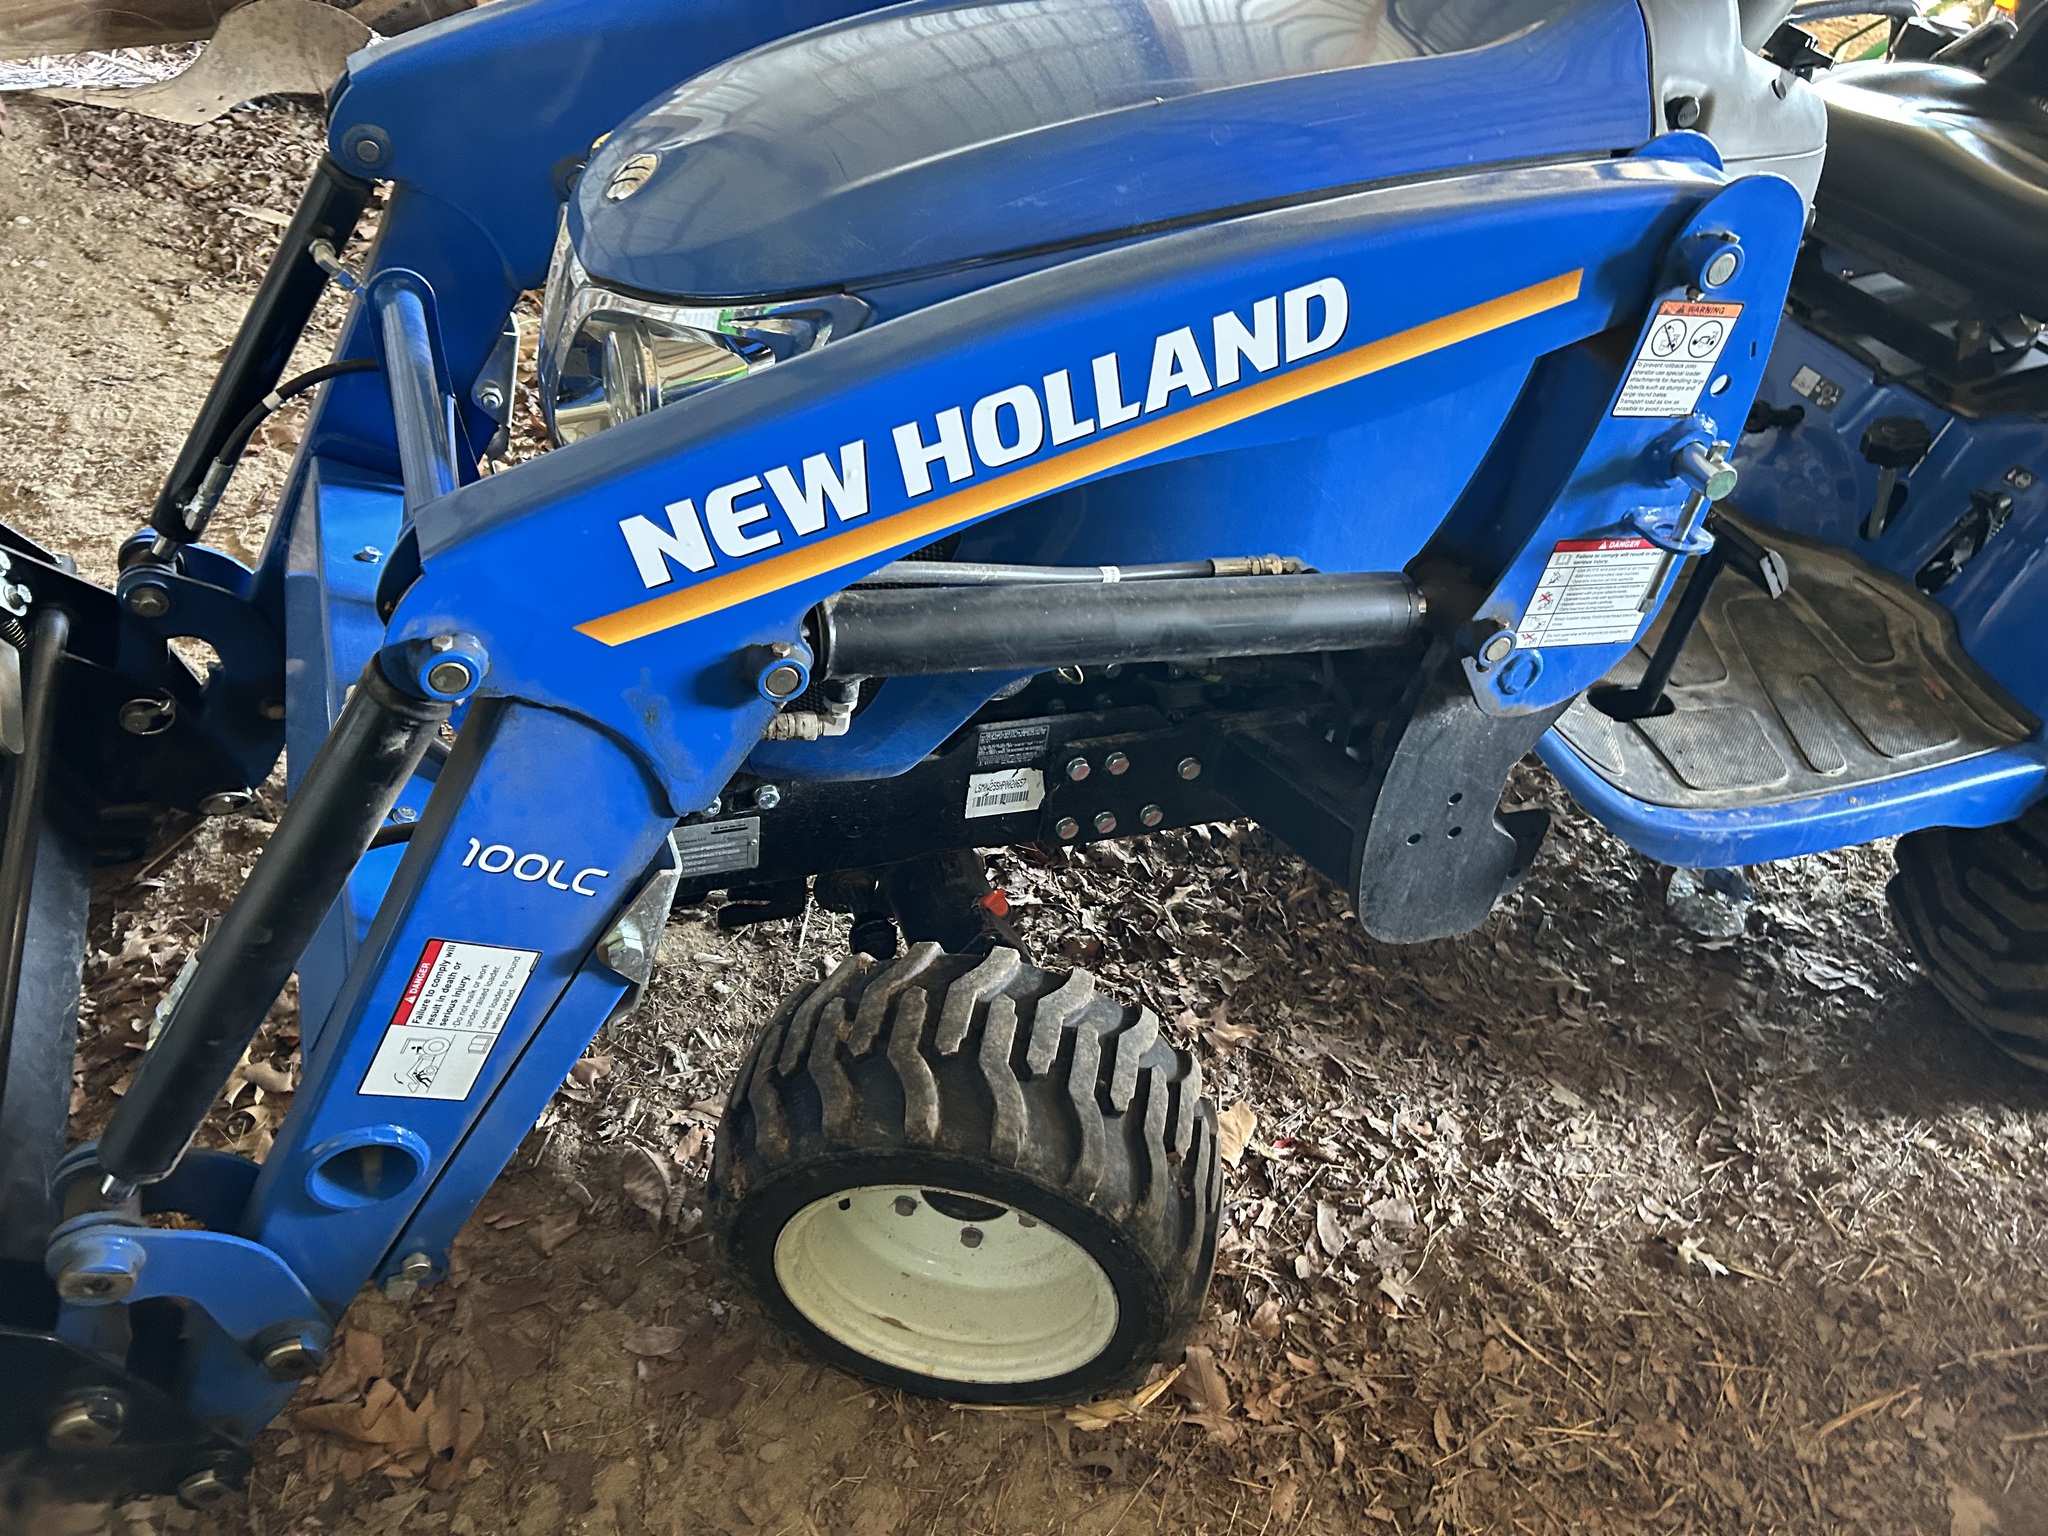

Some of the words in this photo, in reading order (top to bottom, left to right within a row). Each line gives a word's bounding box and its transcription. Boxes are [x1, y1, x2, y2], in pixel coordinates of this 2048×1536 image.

[1688, 306, 1725, 315] WARNING
[619, 439, 868, 590] NEW
[892, 277, 1349, 497] HOLLAND
[1608, 541, 1641, 549] DANGER
[462, 837, 610, 897] 100LC
[411, 962, 430, 994] DANGER
[413, 998, 430, 1024] Failure
[431, 960, 450, 987] comply
[444, 944, 455, 957] will
[472, 980, 481, 988] or
[476, 963, 488, 979] work
[489, 988, 504, 1008] loader
[505, 956, 522, 979] ground
[426, 1003, 441, 1025] result
[441, 971, 456, 993] death
[453, 961, 462, 970] or
[441, 999, 457, 1026] serious
[453, 974, 471, 997] injury.
[458, 1004, 468, 1015] not
[464, 989, 476, 1003] walk
[465, 1008, 478, 1026] under
[475, 987, 489, 1007] raised
[485, 965, 500, 986] loader.
[491, 1012, 502, 1028] when
[501, 987, 517, 1011] parked.
